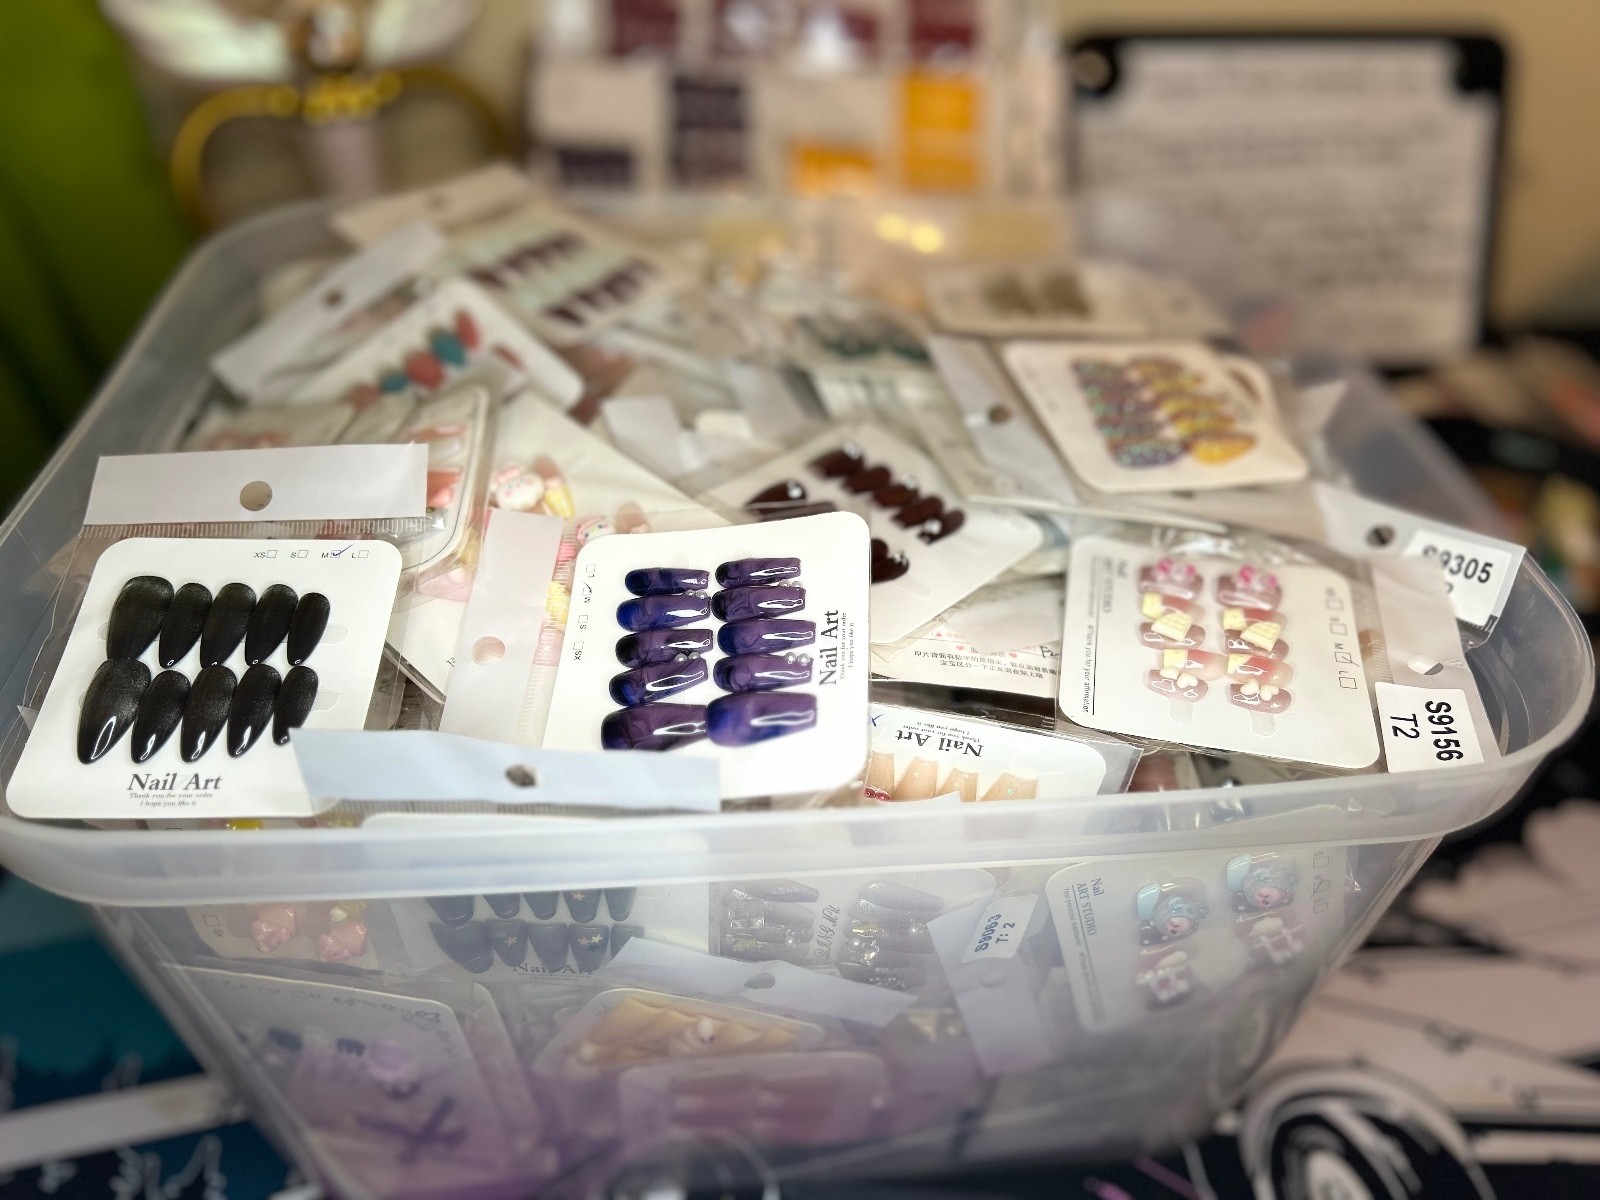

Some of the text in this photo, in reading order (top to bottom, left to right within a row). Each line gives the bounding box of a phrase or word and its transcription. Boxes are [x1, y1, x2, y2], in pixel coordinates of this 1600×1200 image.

[819, 609, 838, 686] Nail Art
[1390, 713, 1420, 739] T2
[1425, 700, 1464, 761] S9156
[895, 729, 984, 757] Nail Art
[126, 773, 223, 790] Nail Art
[1077, 883, 1090, 900] ART
[1091, 878, 1104, 896] Nail
[974, 914, 1002, 952] S9063
[1081, 902, 1097, 936] STUDIO
